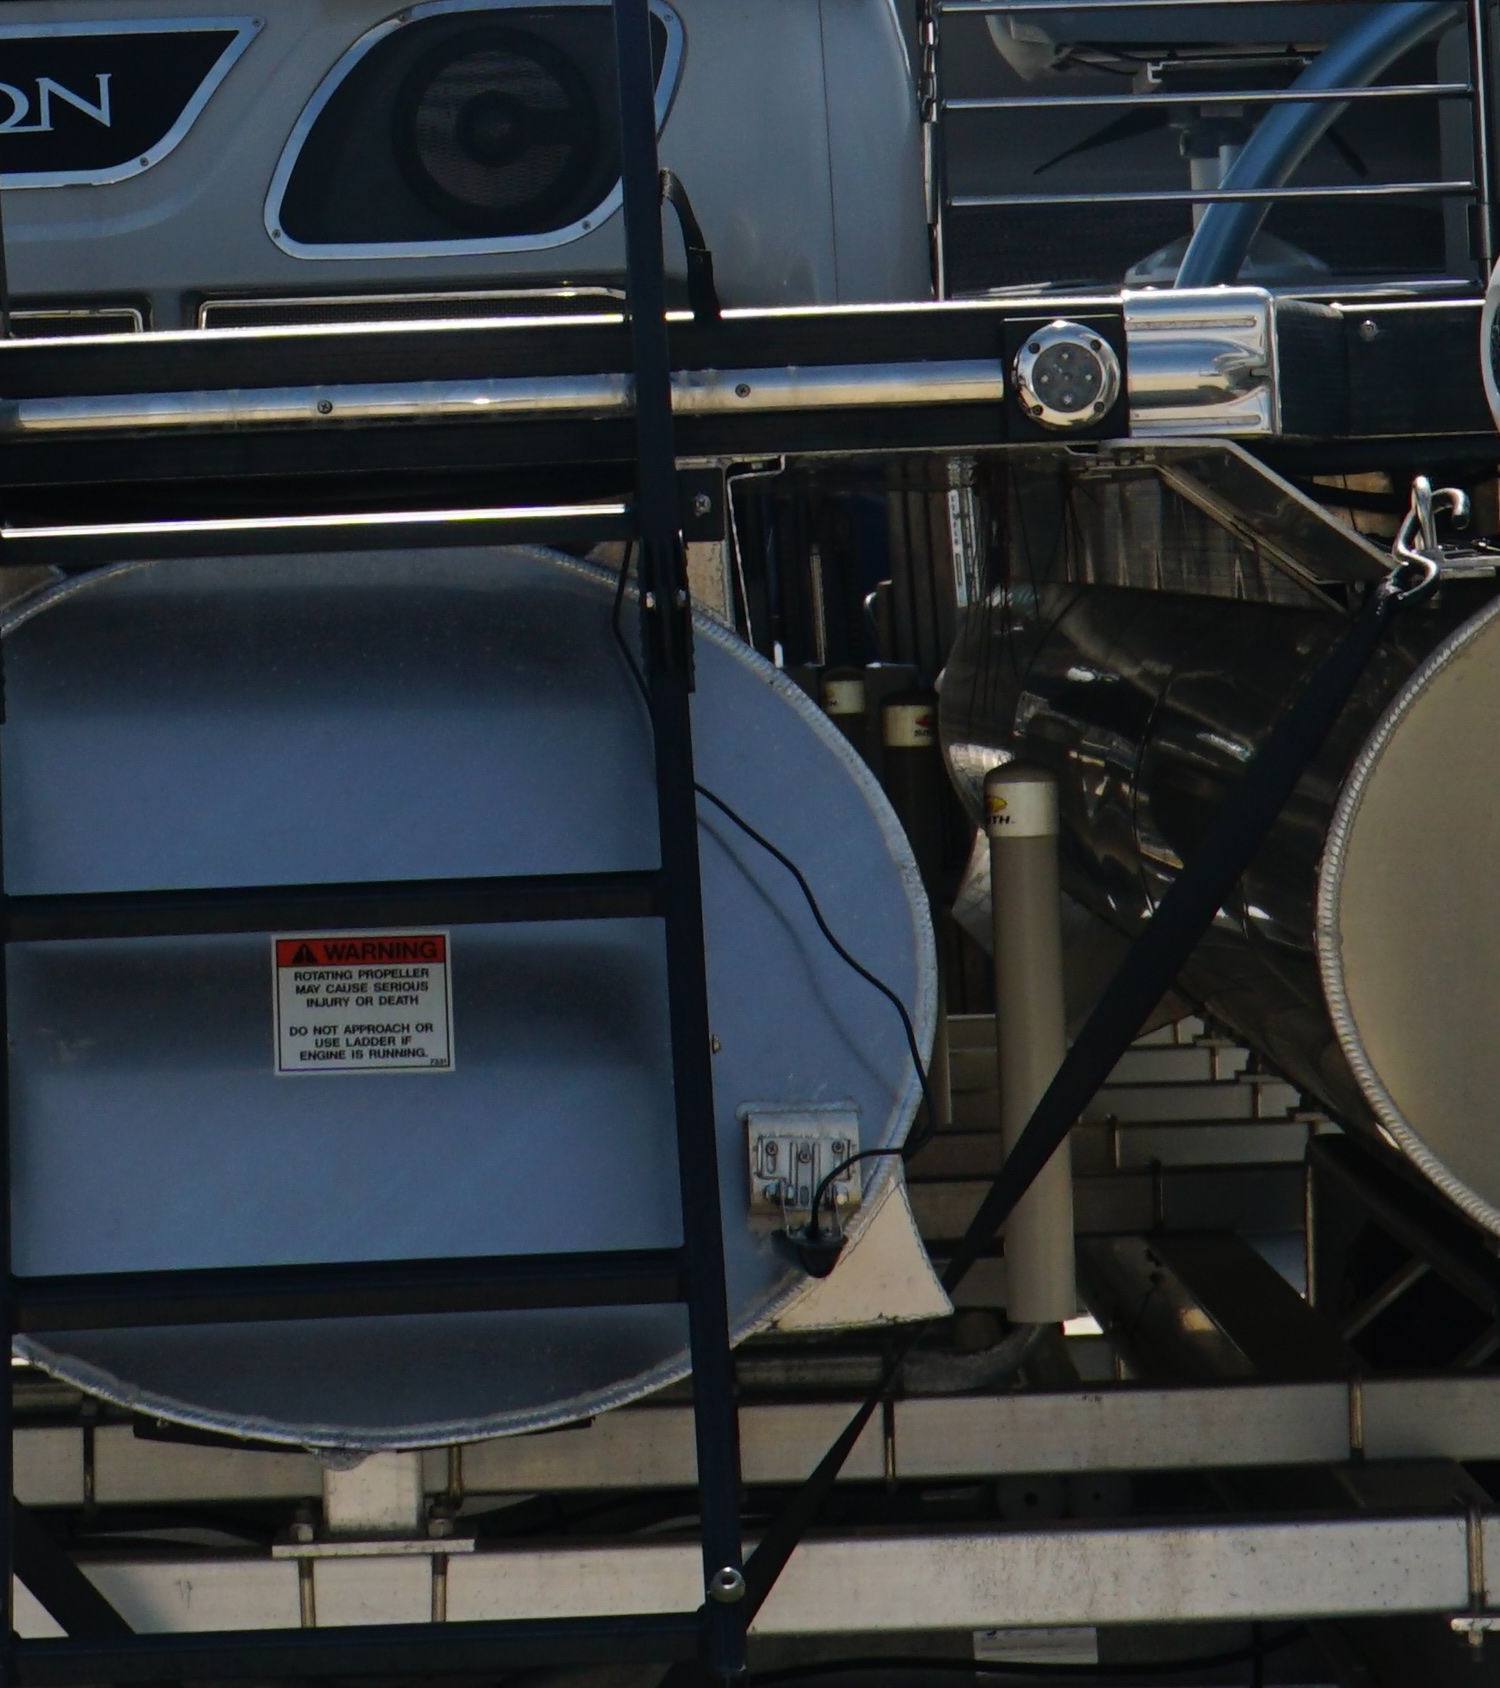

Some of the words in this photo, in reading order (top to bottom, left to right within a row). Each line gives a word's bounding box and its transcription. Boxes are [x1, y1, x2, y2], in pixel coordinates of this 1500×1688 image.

[324, 941, 438, 961] WARNING
[294, 970, 353, 982] ROTATING
[358, 968, 429, 980] PROPELLER
[296, 984, 321, 994] MAY
[326, 983, 368, 994] CAUSE
[374, 981, 428, 992] SERIOUS
[306, 996, 349, 1007] INJURY
[356, 996, 373, 1006] OR
[379, 995, 419, 1006] DEATH
[289, 1026, 308, 1036] DO
[313, 1025, 338, 1035] NOT
[344, 1023, 410, 1035] APPROACH
[415, 1023, 433, 1033] OR
[315, 1037, 340, 1047] USE
[346, 1036, 396, 1047] LADDER
[401, 1035, 412, 1045] IF
[300, 1050, 346, 1061] ENGINE
[352, 1050, 363, 1060] IS
[369, 1048, 429, 1060] RUNNING.
